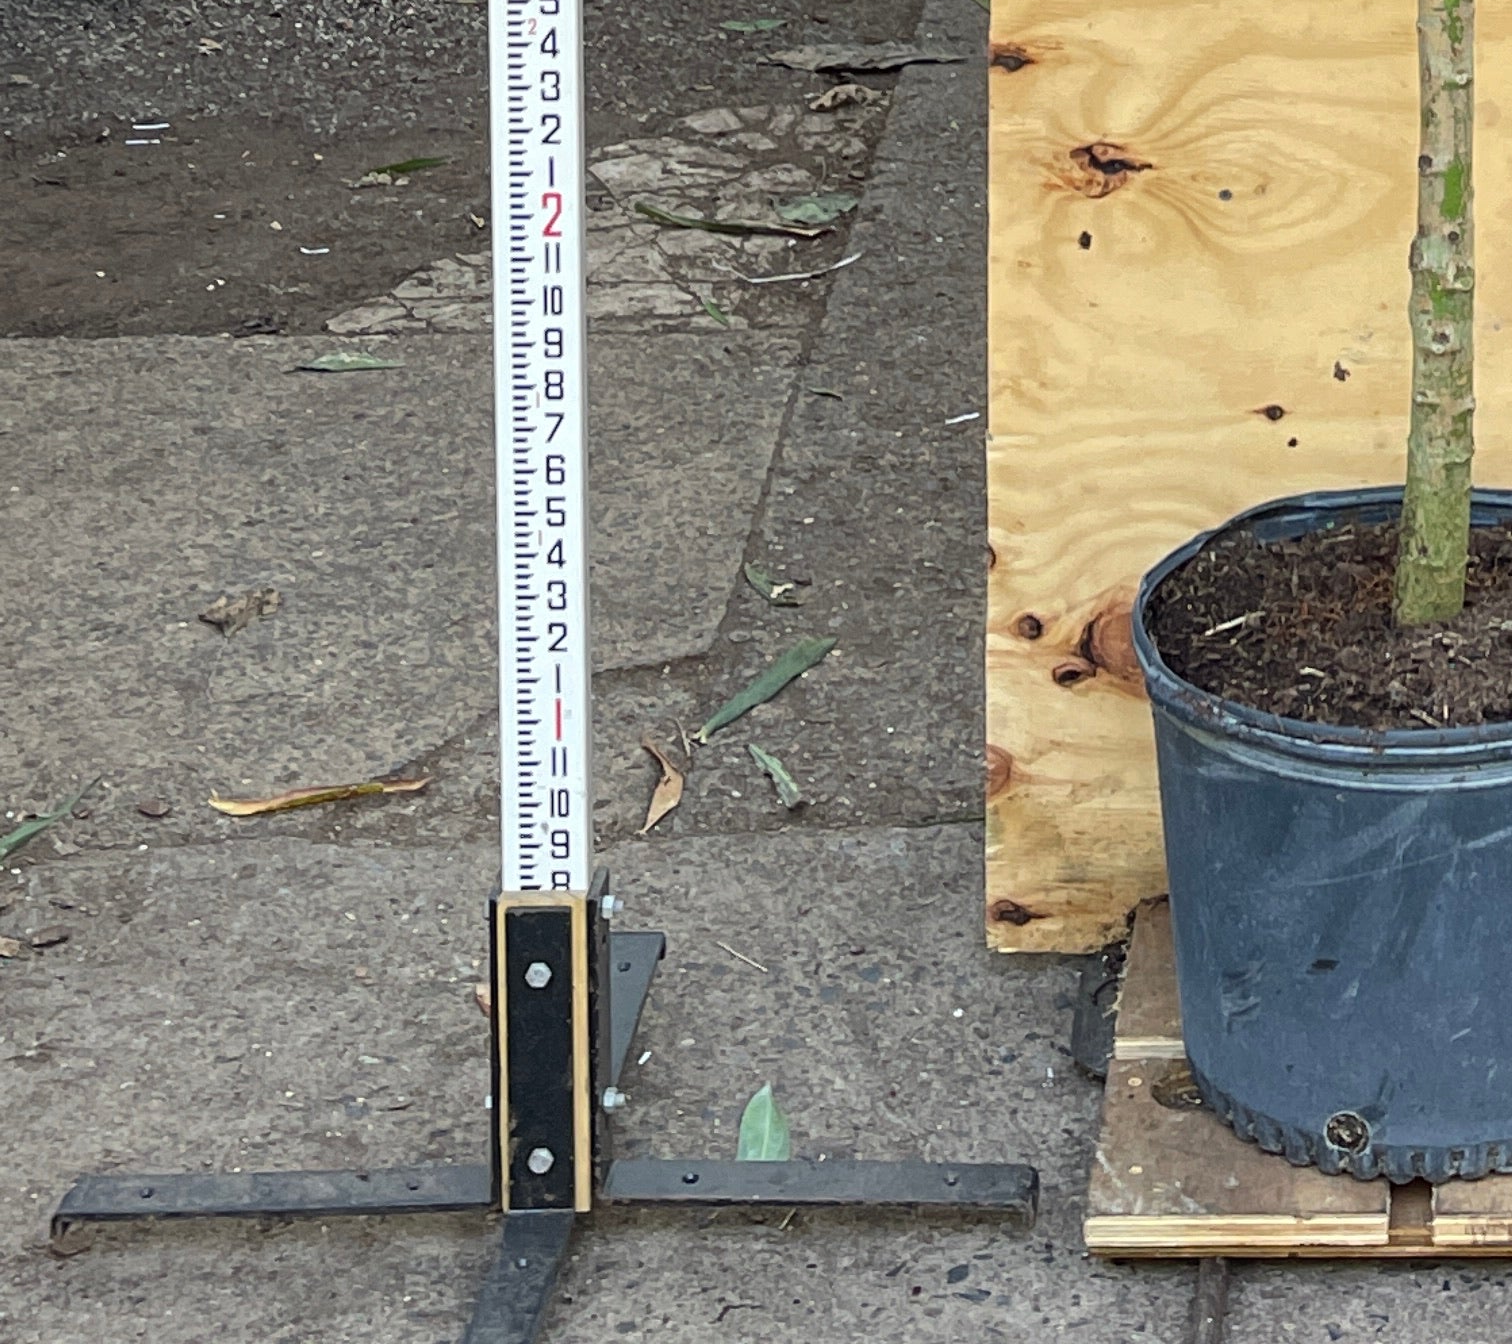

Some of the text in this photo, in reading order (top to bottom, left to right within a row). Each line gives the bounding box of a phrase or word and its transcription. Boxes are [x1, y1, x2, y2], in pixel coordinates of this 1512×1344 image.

[539, 26, 561, 59] 4
[539, 70, 561, 102] 3
[540, 113, 562, 146] 2
[541, 191, 563, 238] 2
[544, 241, 561, 274] 11
[542, 284, 564, 317] 10
[543, 326, 564, 359] 9
[543, 369, 565, 402] 8
[544, 411, 565, 444] 7
[545, 453, 566, 486] 6
[544, 495, 567, 528] 5
[546, 537, 567, 570] 4
[546, 579, 568, 612] 3
[547, 621, 568, 653] 2
[550, 746, 568, 778] 11
[549, 787, 570, 819] 10
[550, 828, 571, 860] 9
